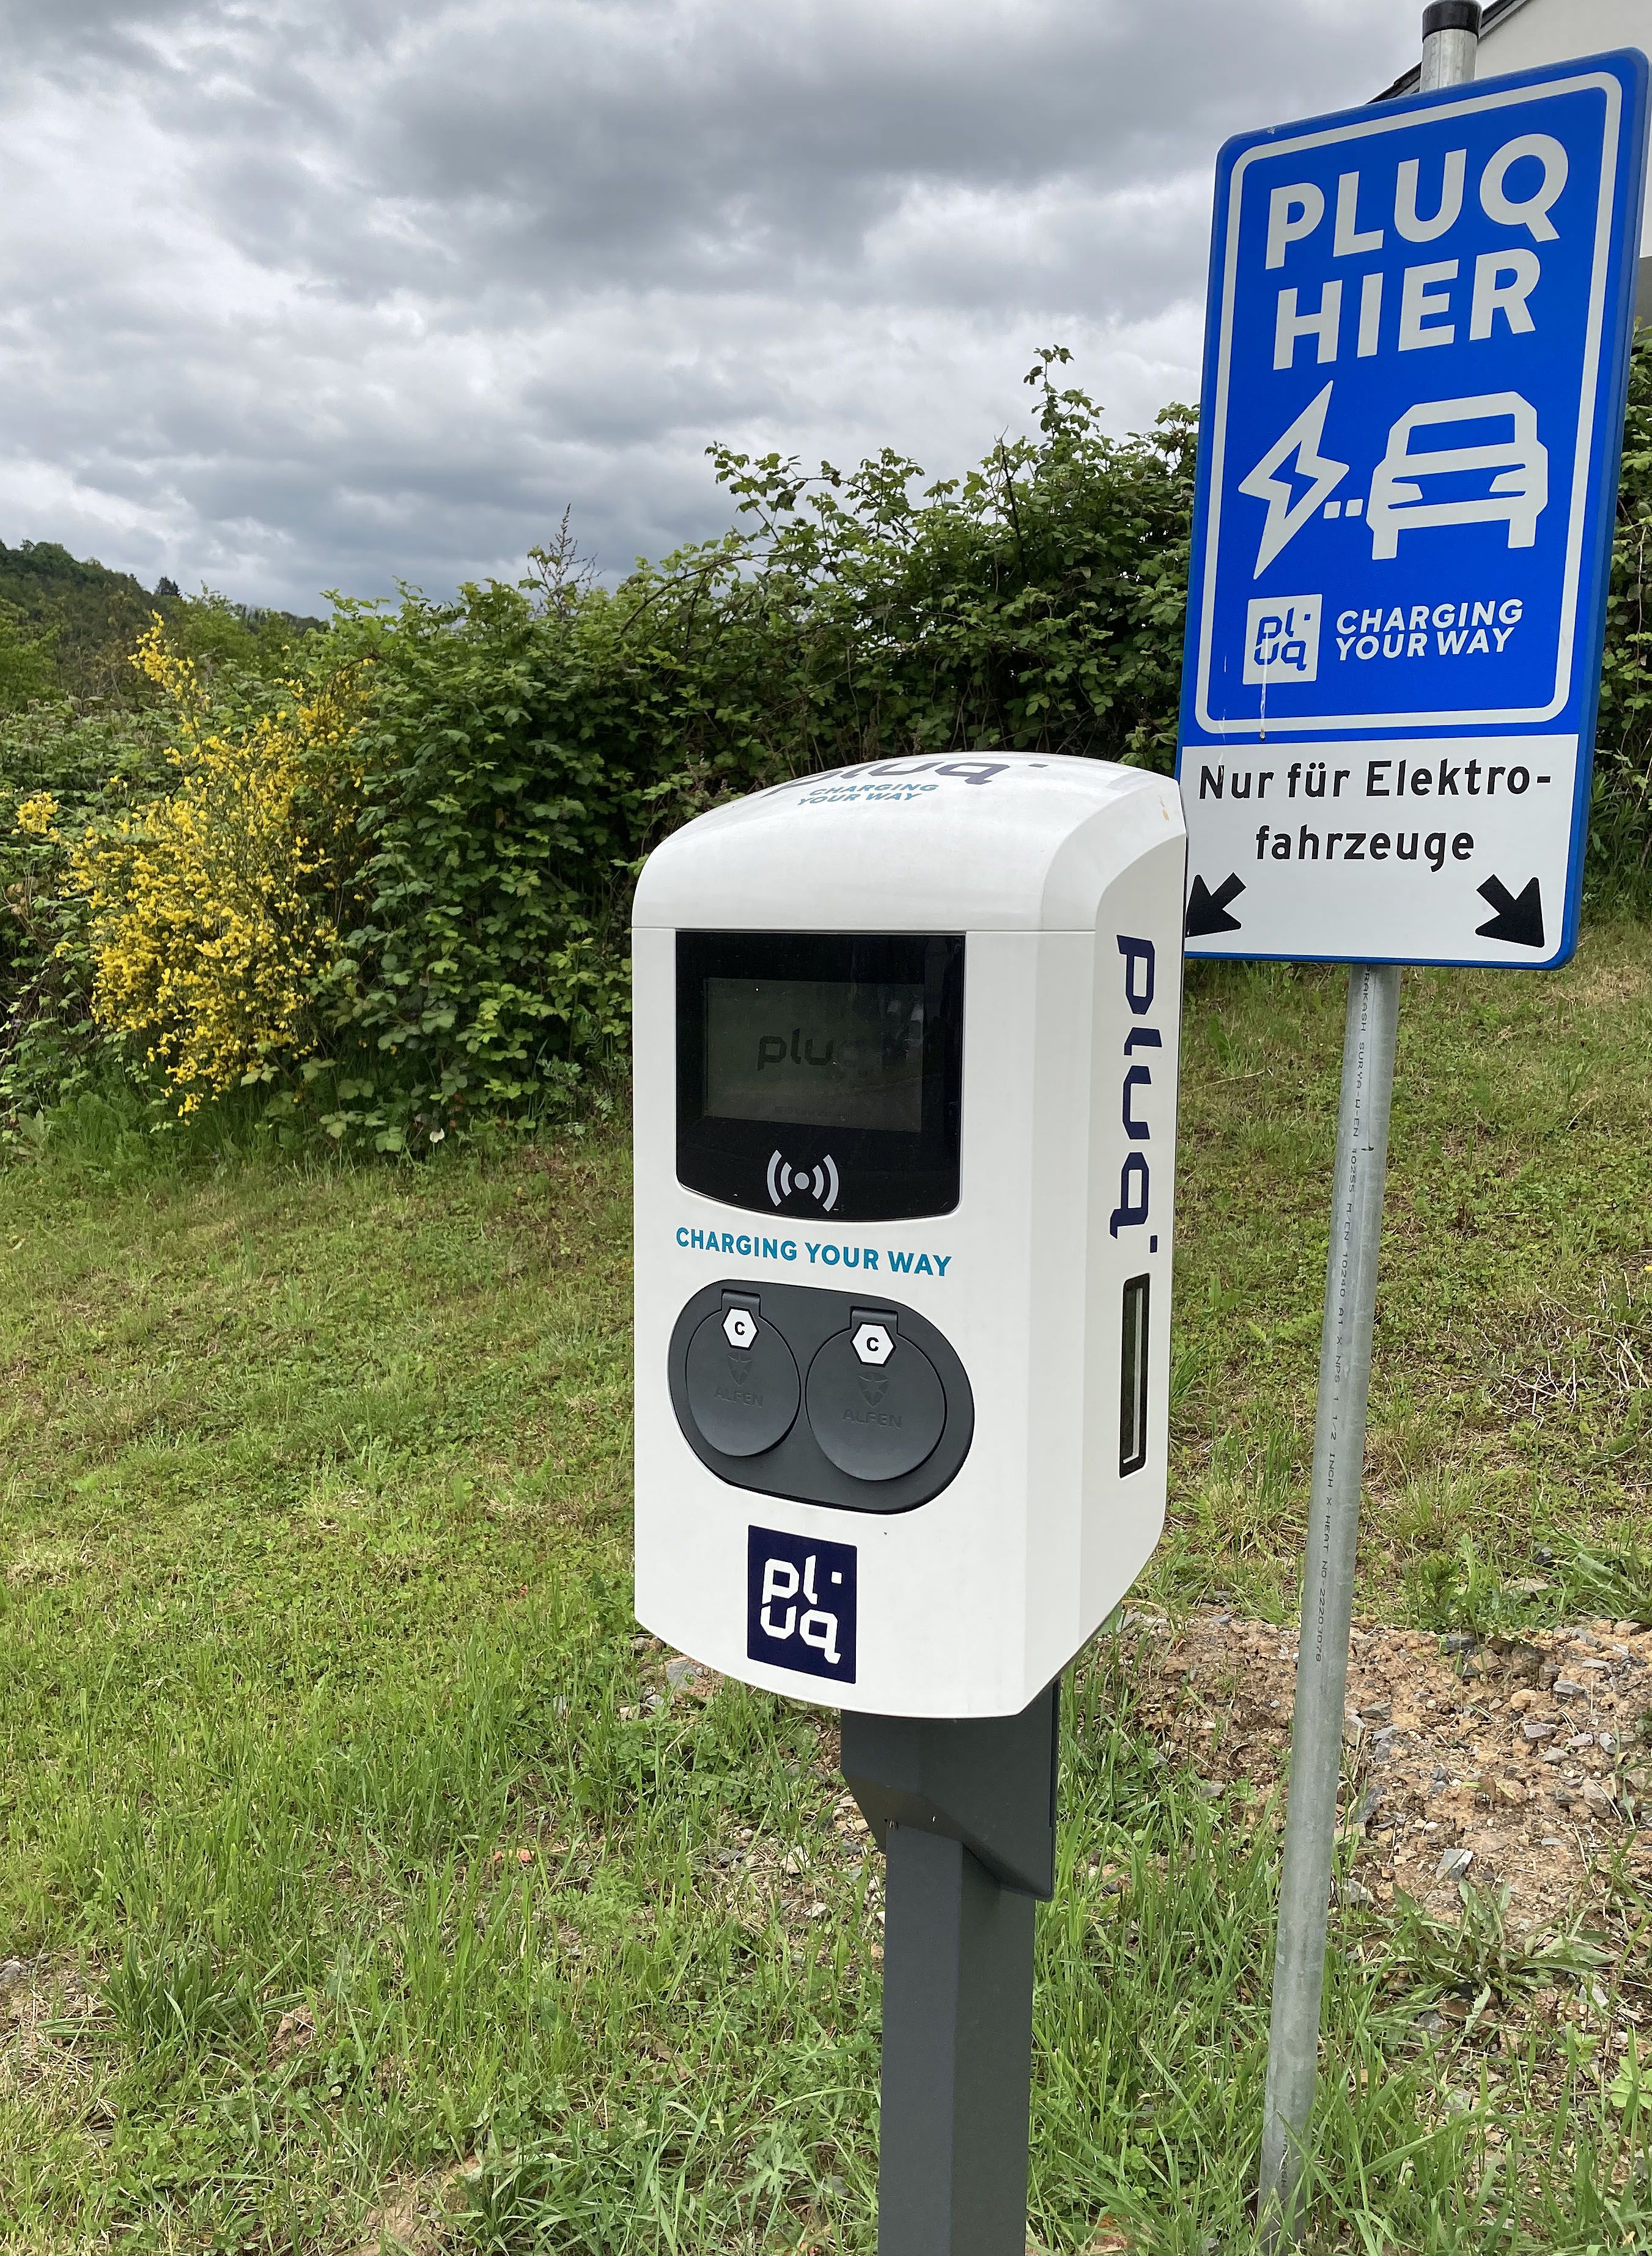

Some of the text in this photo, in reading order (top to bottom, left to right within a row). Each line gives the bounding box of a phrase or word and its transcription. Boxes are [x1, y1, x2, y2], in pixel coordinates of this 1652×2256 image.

[1265, 133, 1569, 269] PLUQ
[1273, 248, 1540, 370] HIER
[1336, 599, 1523, 635] CHARGING
[1336, 627, 1515, 660] YOUR WAY
[809, 784, 938, 796] CHARGING
[1199, 758, 1551, 800] Nur für Elektro-
[797, 793, 923, 806] YOUR WAY
[1256, 824, 1474, 872] fahrzeuge
[1360, 964, 1371, 1031] PRAKASH
[676, 1227, 952, 1277] CHARGING YOUR WAY
[734, 1321, 745, 1336] C
[866, 1337, 879, 1352] C
[714, 1387, 763, 1408] ALFEN
[841, 1409, 902, 1429] ALFEN
[1327, 1453, 1335, 1487] INCH
